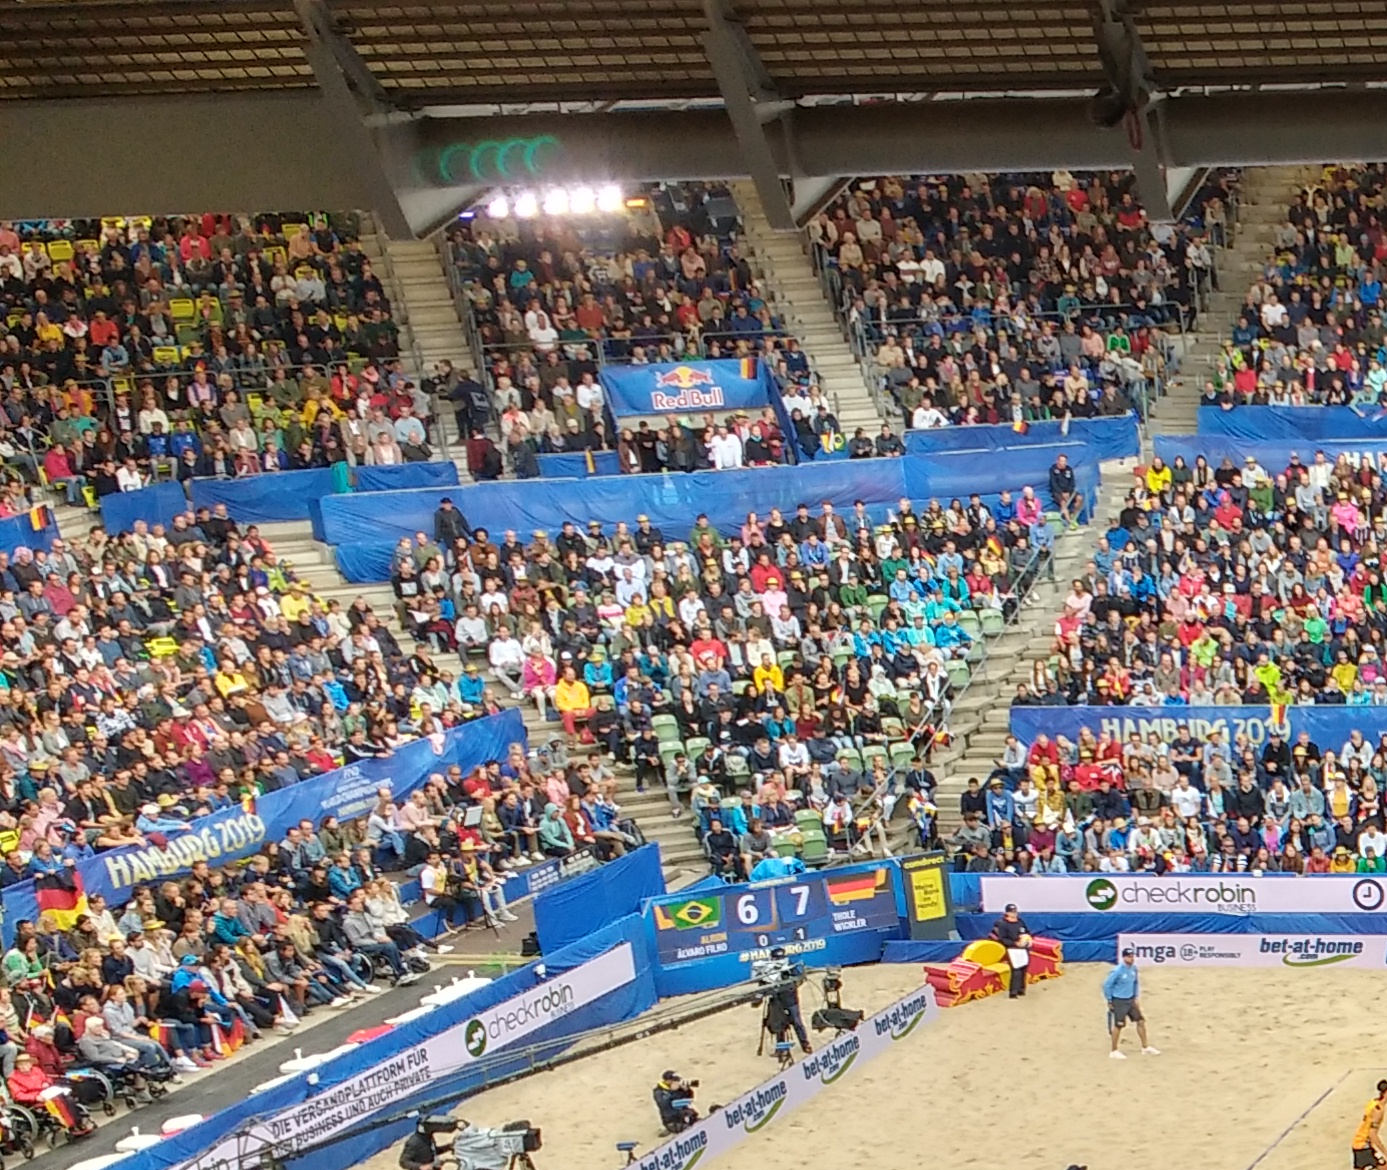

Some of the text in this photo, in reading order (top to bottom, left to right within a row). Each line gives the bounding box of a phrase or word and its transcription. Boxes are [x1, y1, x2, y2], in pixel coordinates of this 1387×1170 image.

[652, 387, 724, 410] Red Bull
[1233, 717, 1291, 744] 2019
[213, 813, 266, 857] 2019
[790, 885, 810, 916] 7
[1122, 881, 1256, 903] checkrobin
[1217, 903, 1257, 911] BUSINESS
[737, 894, 758, 924] 6
[759, 927, 805, 947] 0 1
[1260, 938, 1364, 954] bet-at-home
[490, 983, 574, 1039] checkrobin
[874, 995, 927, 1036] bet-at-home
[802, 1036, 860, 1080] bet-at-home
[271, 1048, 429, 1139] DIE VERSANDPLATTFORM FÜR
[725, 1080, 787, 1129] bet-at-home
